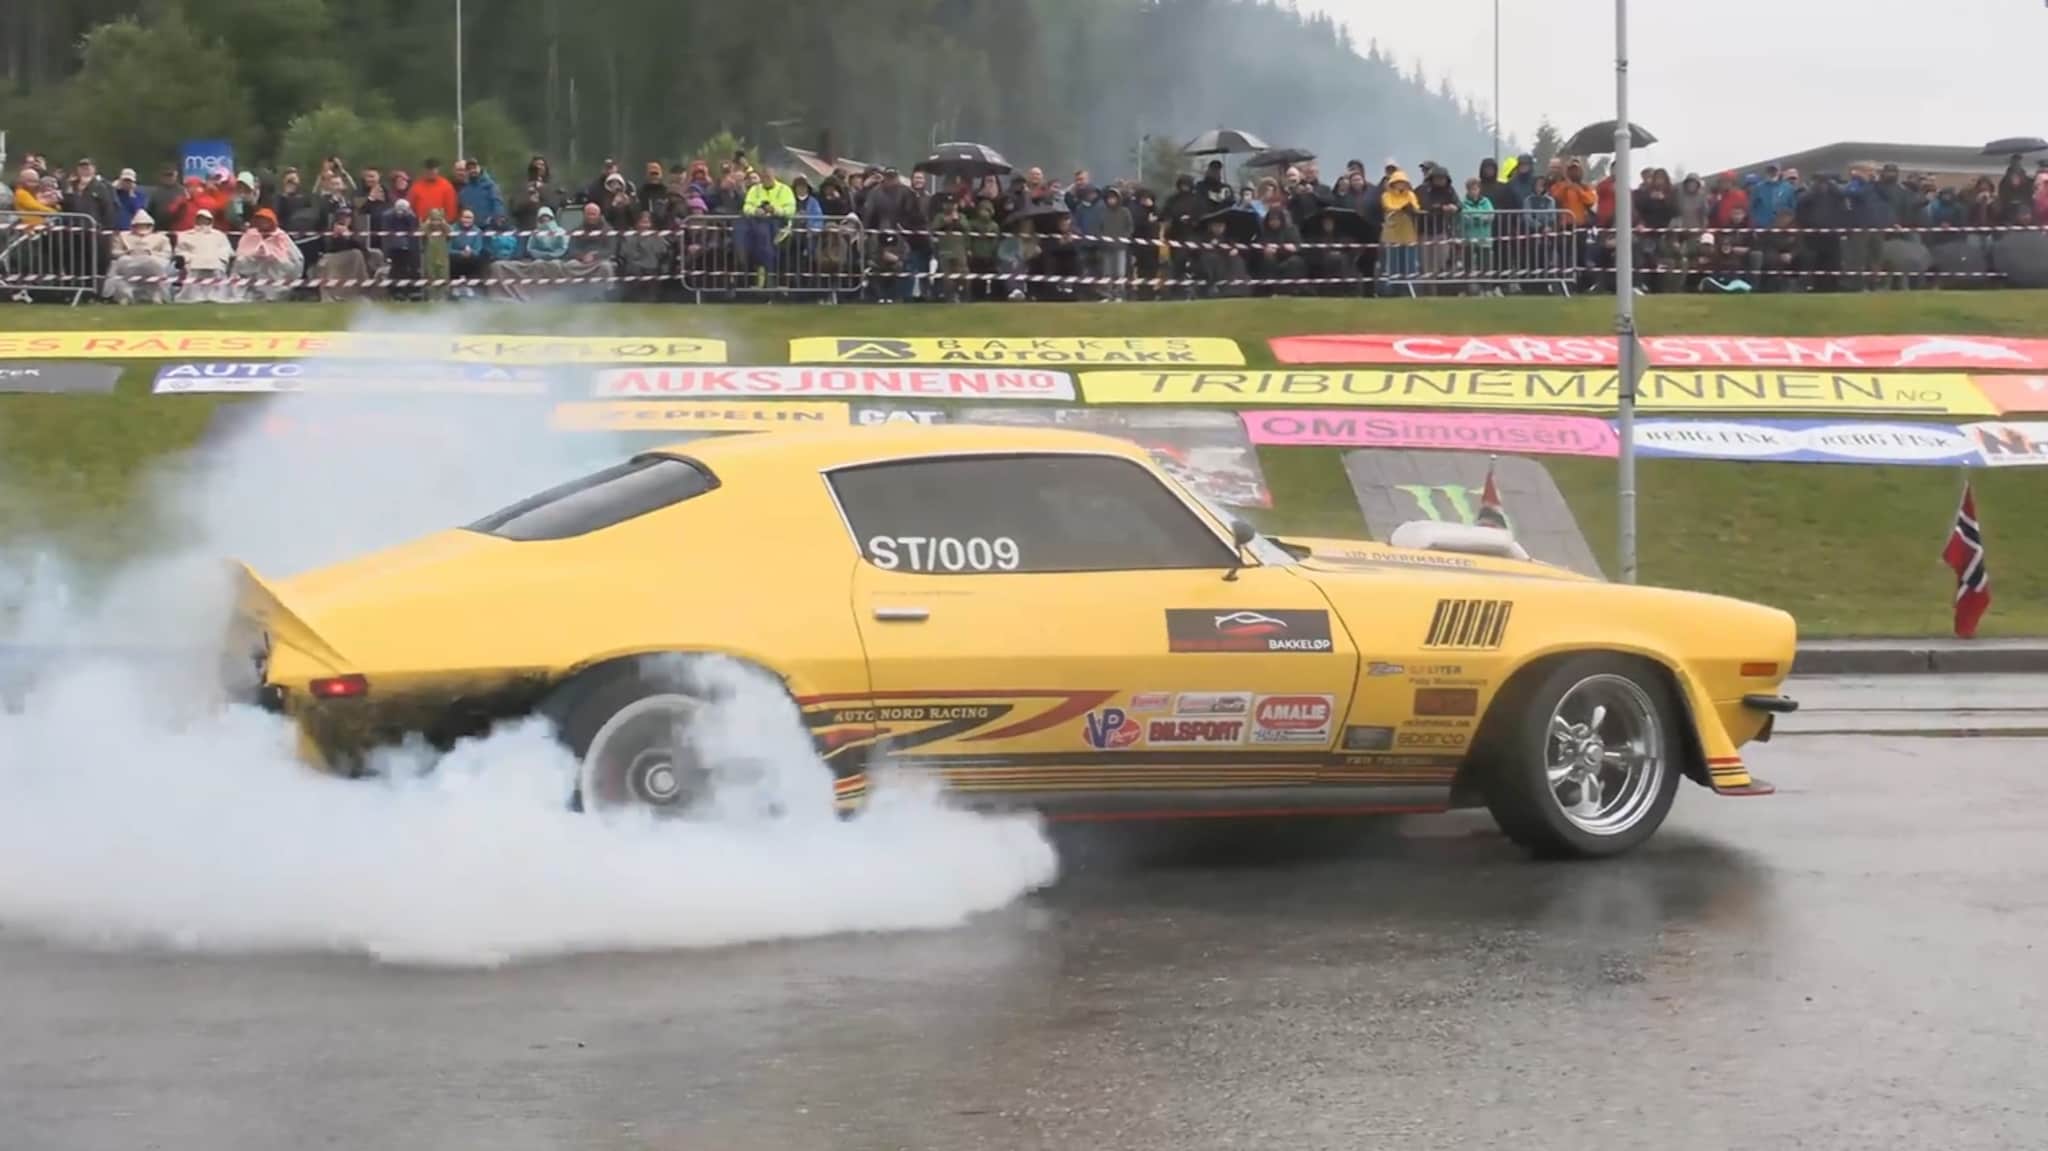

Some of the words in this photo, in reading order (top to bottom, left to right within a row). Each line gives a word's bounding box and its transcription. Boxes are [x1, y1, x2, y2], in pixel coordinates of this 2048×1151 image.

[937, 338, 1190, 350] BAKKES
[1391, 337, 1863, 364] CARSSTEM
[941, 350, 1197, 362] AUTOLAKK
[165, 363, 305, 377] AUTO
[609, 370, 991, 393] AUKSJONEN
[1895, 389, 1942, 401] NO
[858, 409, 945, 424] CAT
[868, 535, 1020, 572] ST/009
[1268, 638, 1332, 650] BAKKELØP
[880, 708, 925, 720] NORD
[929, 706, 989, 719] RACING
[1261, 703, 1327, 720] AMALIE
[1087, 708, 1126, 749] VP
[1149, 721, 1244, 742] BILSPORT
